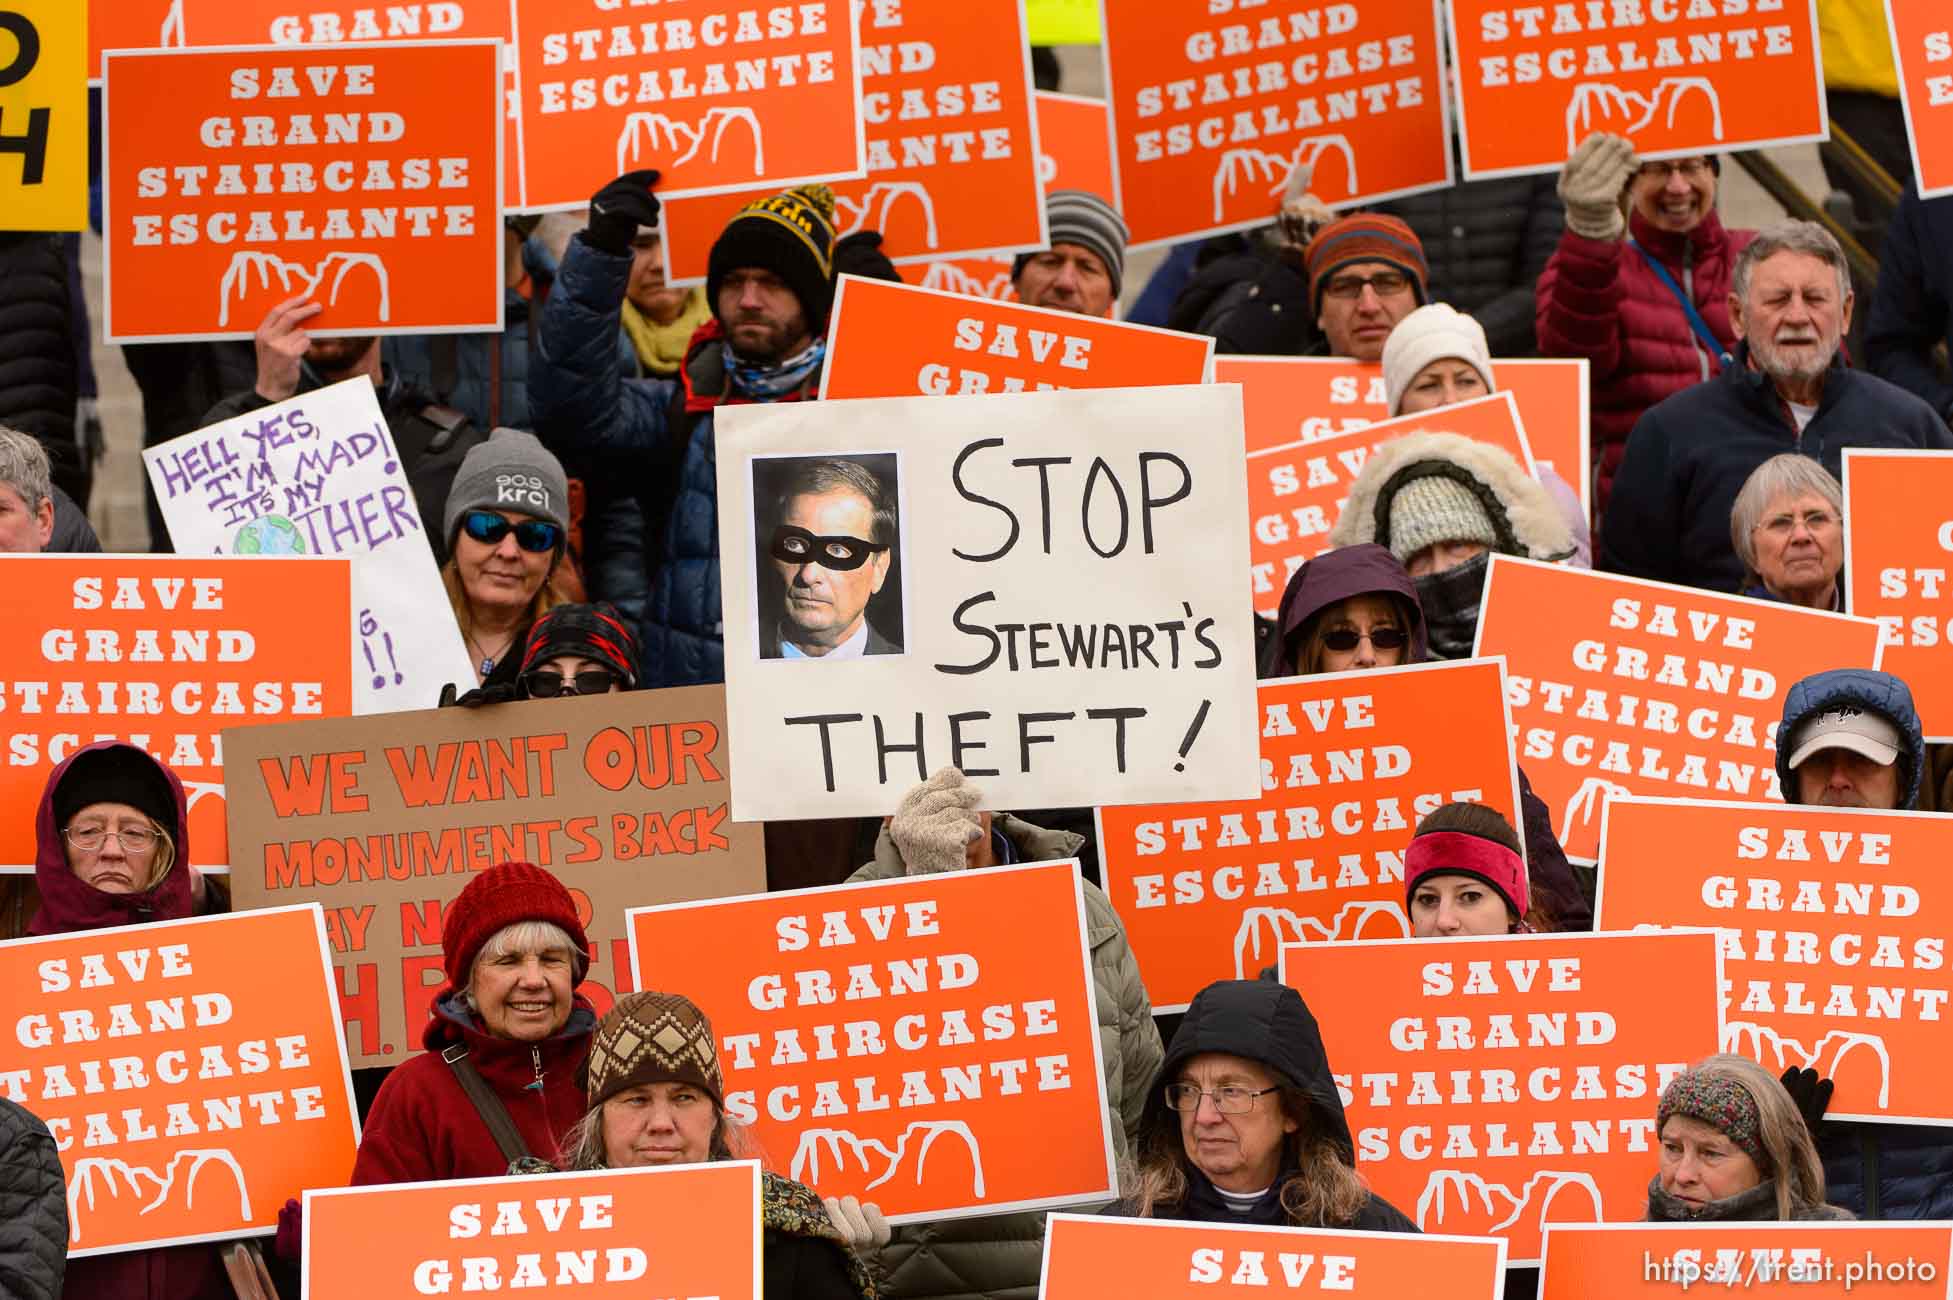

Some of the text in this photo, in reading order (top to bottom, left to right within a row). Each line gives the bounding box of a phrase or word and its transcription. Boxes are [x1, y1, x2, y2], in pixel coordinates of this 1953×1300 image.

[270, 2, 464, 44] GRAND
[543, 3, 827, 64] STAIRCASE
[1186, 4, 1358, 62] GRAND
[539, 50, 834, 113] ESCALANTE
[1136, 35, 1415, 118] STAIRCASE
[1480, 26, 1792, 86] ESCALANTE
[231, 66, 373, 98] SAVE
[201, 113, 404, 147] GRAND
[1135, 77, 1422, 162] ESCALANTE
[139, 159, 468, 197] STAIRCASE
[133, 206, 473, 245] ESCALANTE
[955, 319, 1091, 369] SAVE
[156, 410, 320, 498] HELL YES,
[205, 423, 398, 511] I'M MAD!
[1269, 443, 1381, 496] SAV
[284, 475, 325, 516] MY
[496, 474, 543, 490] 90.9
[498, 486, 549, 510] krcl
[951, 438, 1193, 563] STOP
[73, 577, 223, 610] SAVE
[41, 629, 255, 662] GRAND
[933, 590, 1223, 675] STEWART'S
[1610, 598, 1756, 650] SAVE
[1572, 640, 1776, 700] GRAND
[0, 682, 322, 714] TAIRCASE
[1262, 695, 1375, 738] AVE
[258, 721, 725, 817] WE WANT OUR
[1261, 745, 1411, 791] AND
[1508, 724, 1785, 800] SCALANT
[264, 803, 730, 889] MONUMENTS BACK
[1738, 827, 1891, 865] SAVE
[1133, 849, 1405, 908] ESCALAN
[1702, 876, 1920, 916] GRAND
[776, 901, 939, 952] SAVE
[38, 944, 192, 993] SAVE
[748, 954, 979, 1010] GRAND
[1422, 958, 1580, 996] SAVE
[16, 993, 232, 1048] GRAND
[723, 1000, 1057, 1069] TAIRCASE
[1390, 1012, 1616, 1051] GRAND
[0, 1035, 310, 1102] TAIRCASE
[724, 1054, 1071, 1126] SCALANTE
[46, 1086, 326, 1151] CALANTE
[1358, 1119, 1655, 1162] SCALANT
[449, 1194, 613, 1239] SAVE
[413, 1247, 648, 1295] GRAND
[1189, 1248, 1356, 1291] SAVE
